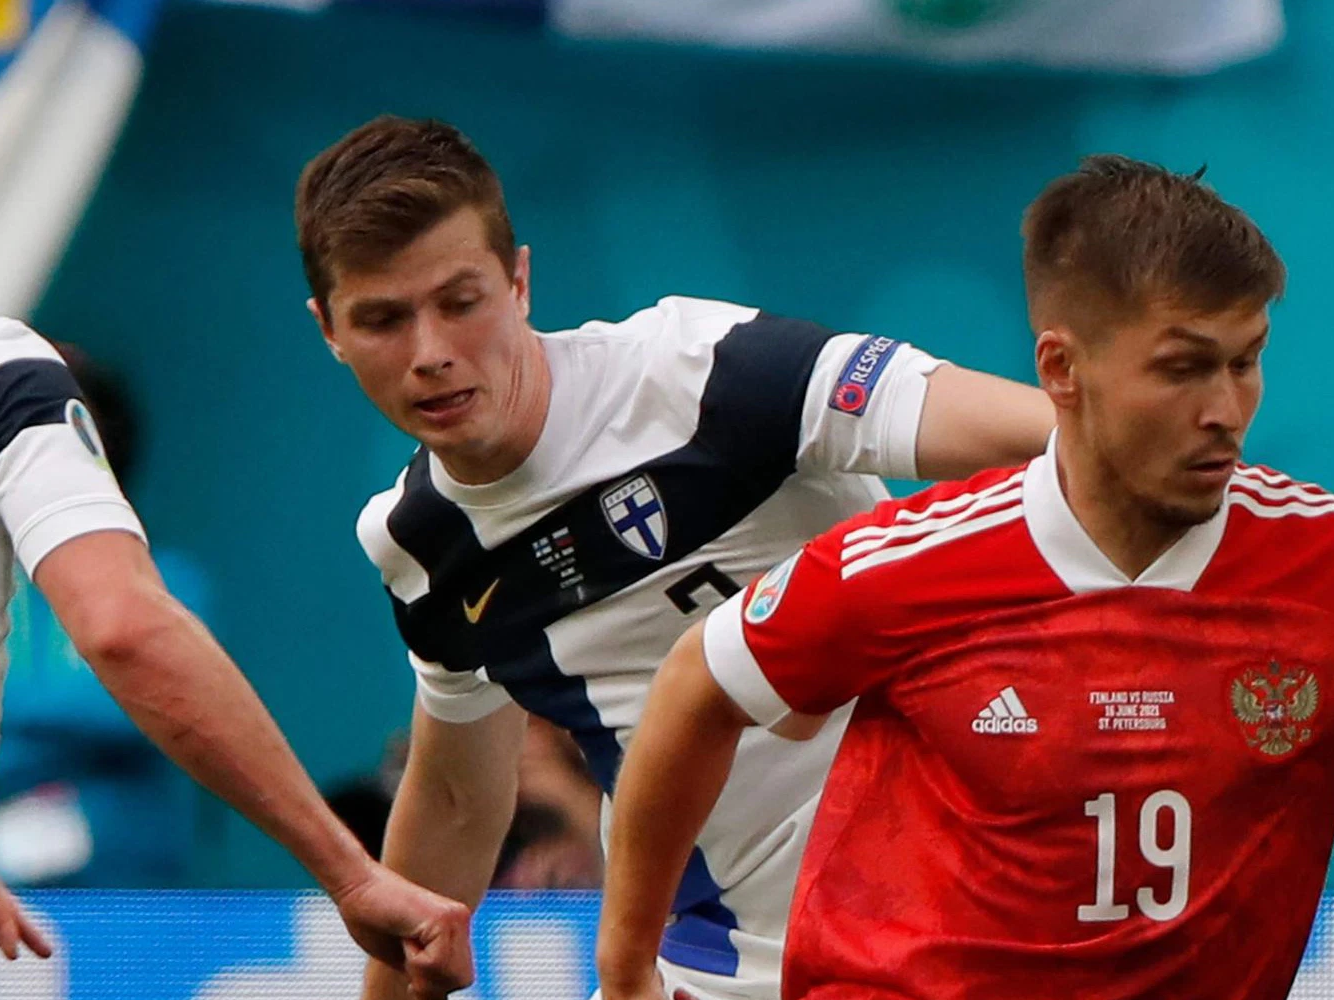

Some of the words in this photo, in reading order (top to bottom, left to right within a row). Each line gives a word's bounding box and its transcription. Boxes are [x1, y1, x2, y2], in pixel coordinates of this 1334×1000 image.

[1089, 691, 1128, 704] FINLAND
[1129, 691, 1141, 703] VS
[1142, 691, 1175, 703] RUSSIA
[1105, 704, 1115, 716] 16
[1116, 704, 1138, 716] JUNE
[1139, 704, 1160, 716] 2021
[971, 715, 1038, 733] adidas
[1113, 718, 1167, 730] PETERSBURG
[1077, 789, 1192, 922] 19
